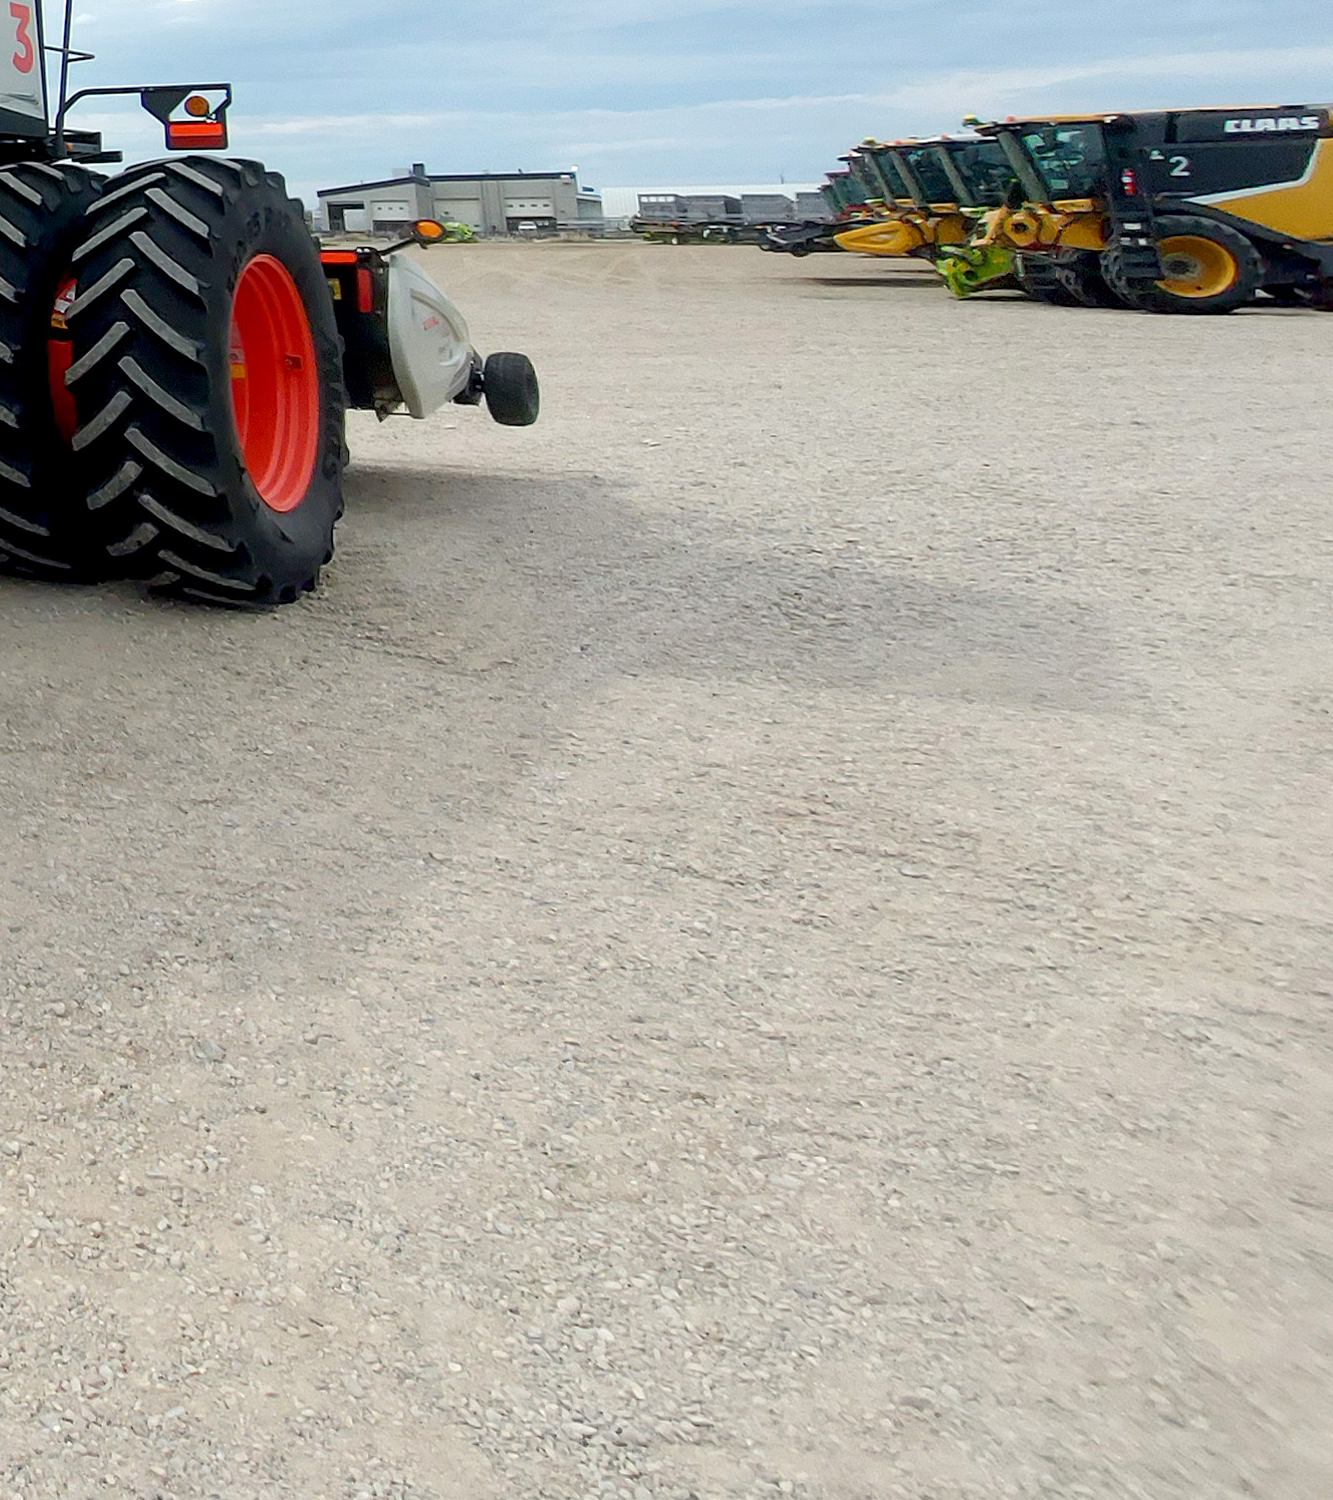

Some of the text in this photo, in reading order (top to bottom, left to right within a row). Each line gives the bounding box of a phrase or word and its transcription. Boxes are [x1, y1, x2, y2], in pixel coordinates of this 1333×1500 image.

[8, 1, 34, 74] 3
[1223, 116, 1320, 133] CLAAS
[1168, 155, 1191, 177] 2
